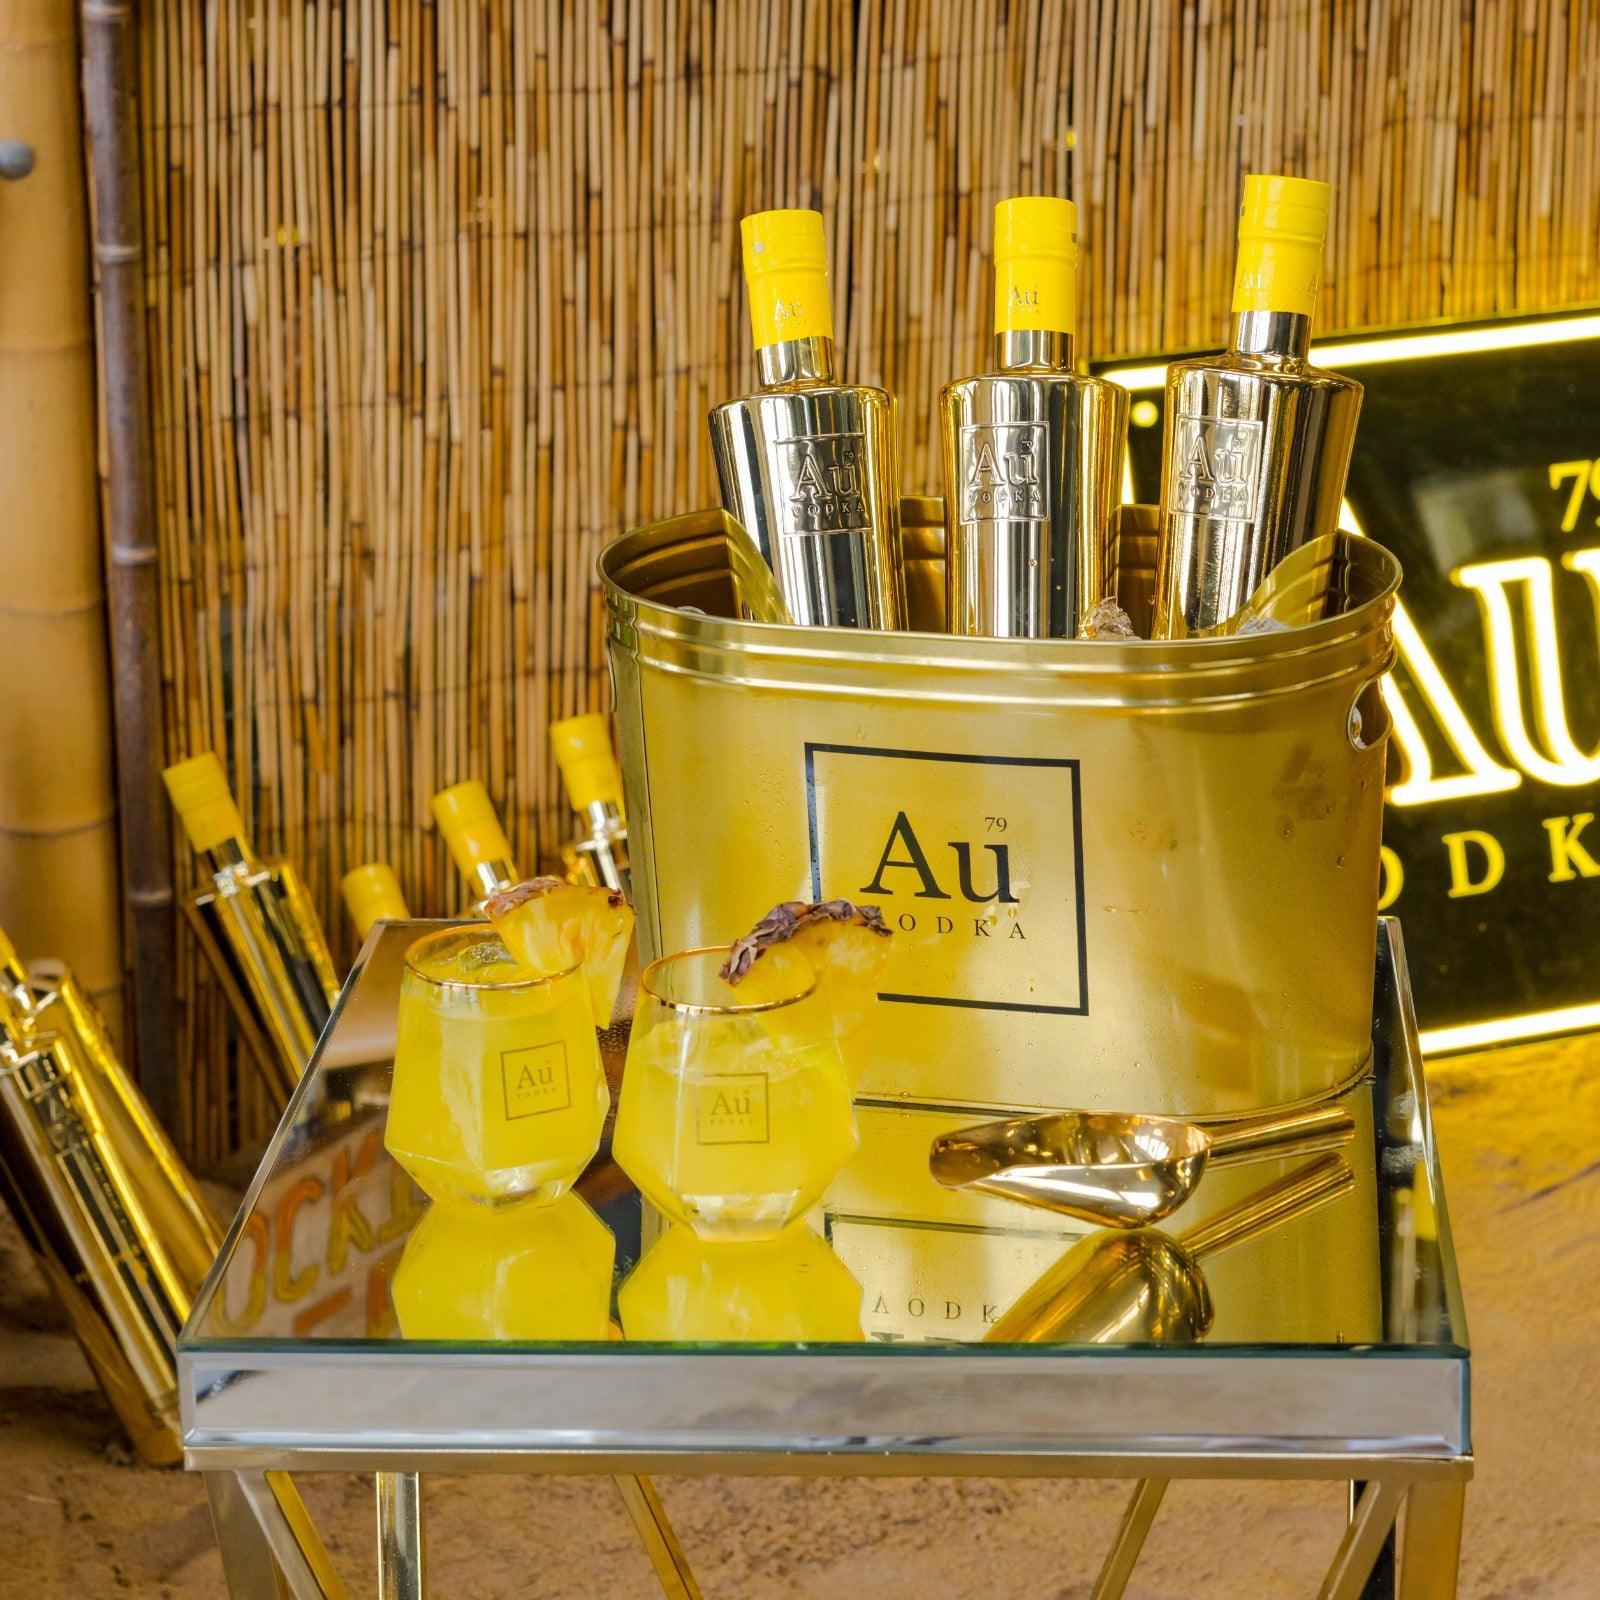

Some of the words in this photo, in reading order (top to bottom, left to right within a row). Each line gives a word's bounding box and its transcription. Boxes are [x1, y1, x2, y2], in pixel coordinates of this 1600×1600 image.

[968, 442, 1039, 487] Au
[1180, 435, 1247, 484] Au
[788, 454, 861, 500] Au
[791, 501, 865, 517] VODKA
[968, 488, 1041, 504] VODKA
[984, 816, 1008, 833] 79
[859, 810, 1021, 904] Au
[898, 913, 1026, 940] ODKA
[516, 1064, 554, 1090] Au
[709, 1090, 752, 1116] Au
